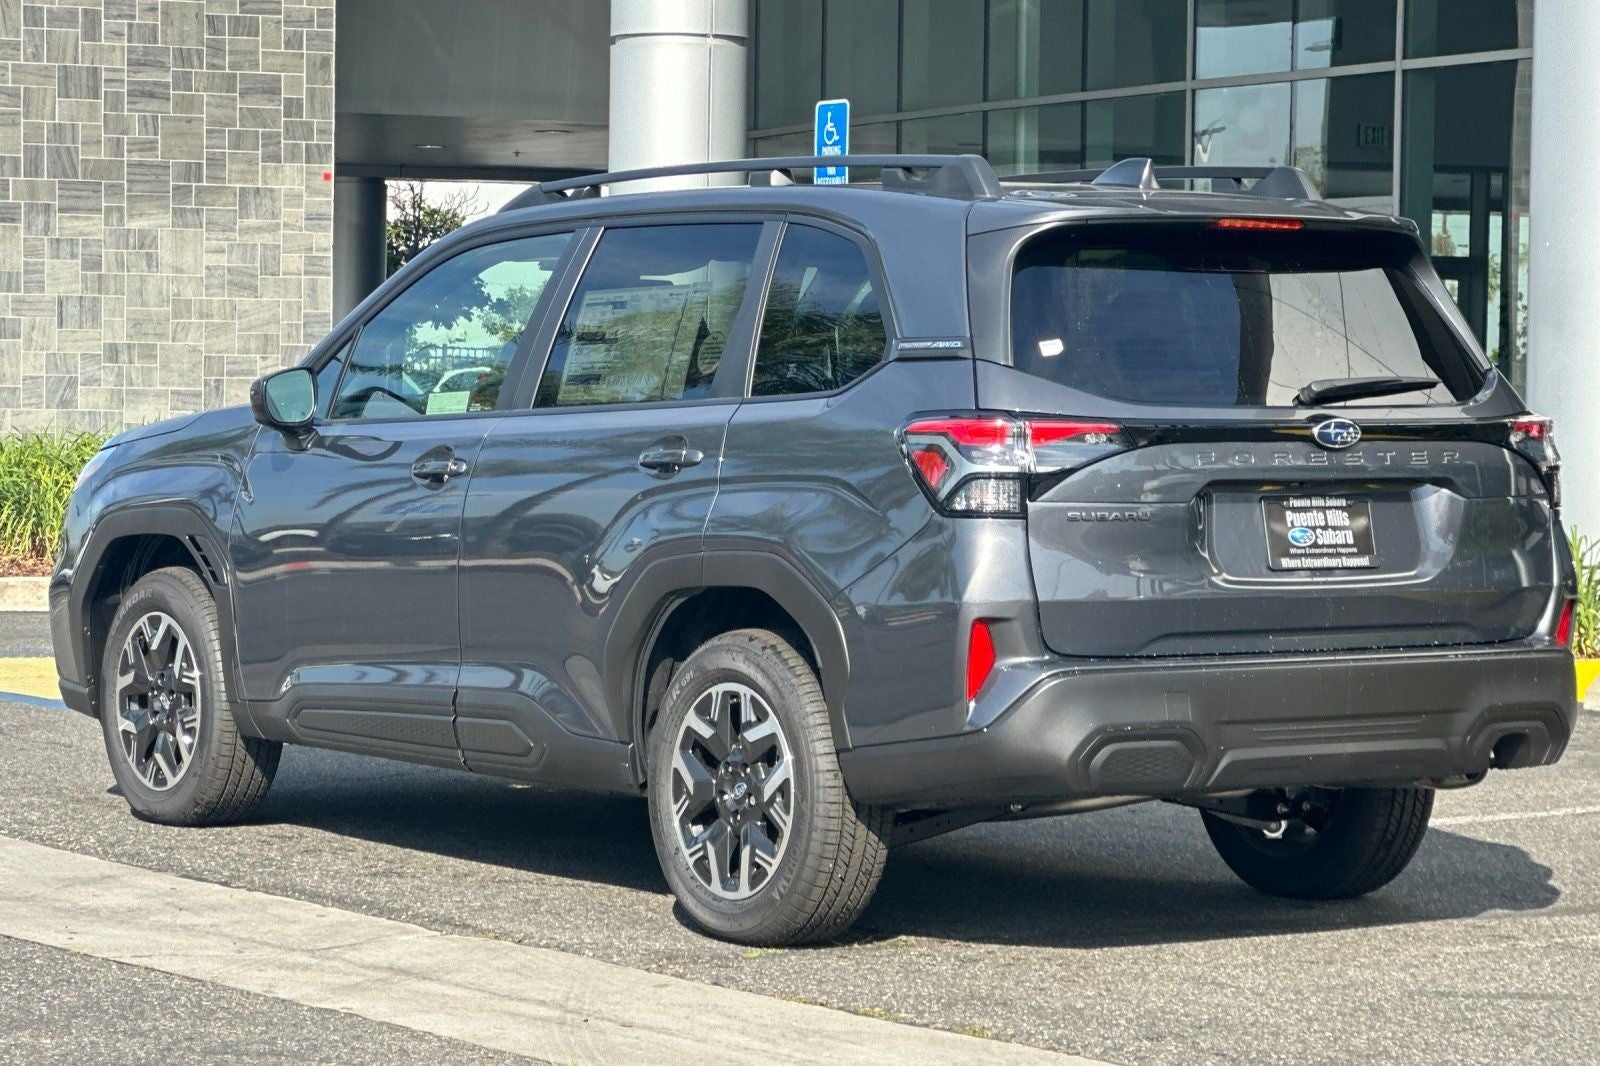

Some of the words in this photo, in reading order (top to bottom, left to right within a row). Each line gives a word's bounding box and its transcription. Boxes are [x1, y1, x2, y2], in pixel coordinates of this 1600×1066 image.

[1365, 125, 1385, 145] EXIT
[1194, 451, 1460, 466] FORESTER
[1289, 497, 1311, 507] Puente
[1312, 497, 1325, 507] Hills
[1325, 496, 1347, 507] Subaru
[1066, 511, 1151, 521] SUBARU
[1285, 510, 1326, 527] Puente
[1326, 509, 1350, 527] Hills
[1315, 528, 1354, 545] Subaru
[1280, 557, 1302, 568] Where
[1302, 556, 1342, 568] Extraordinary
